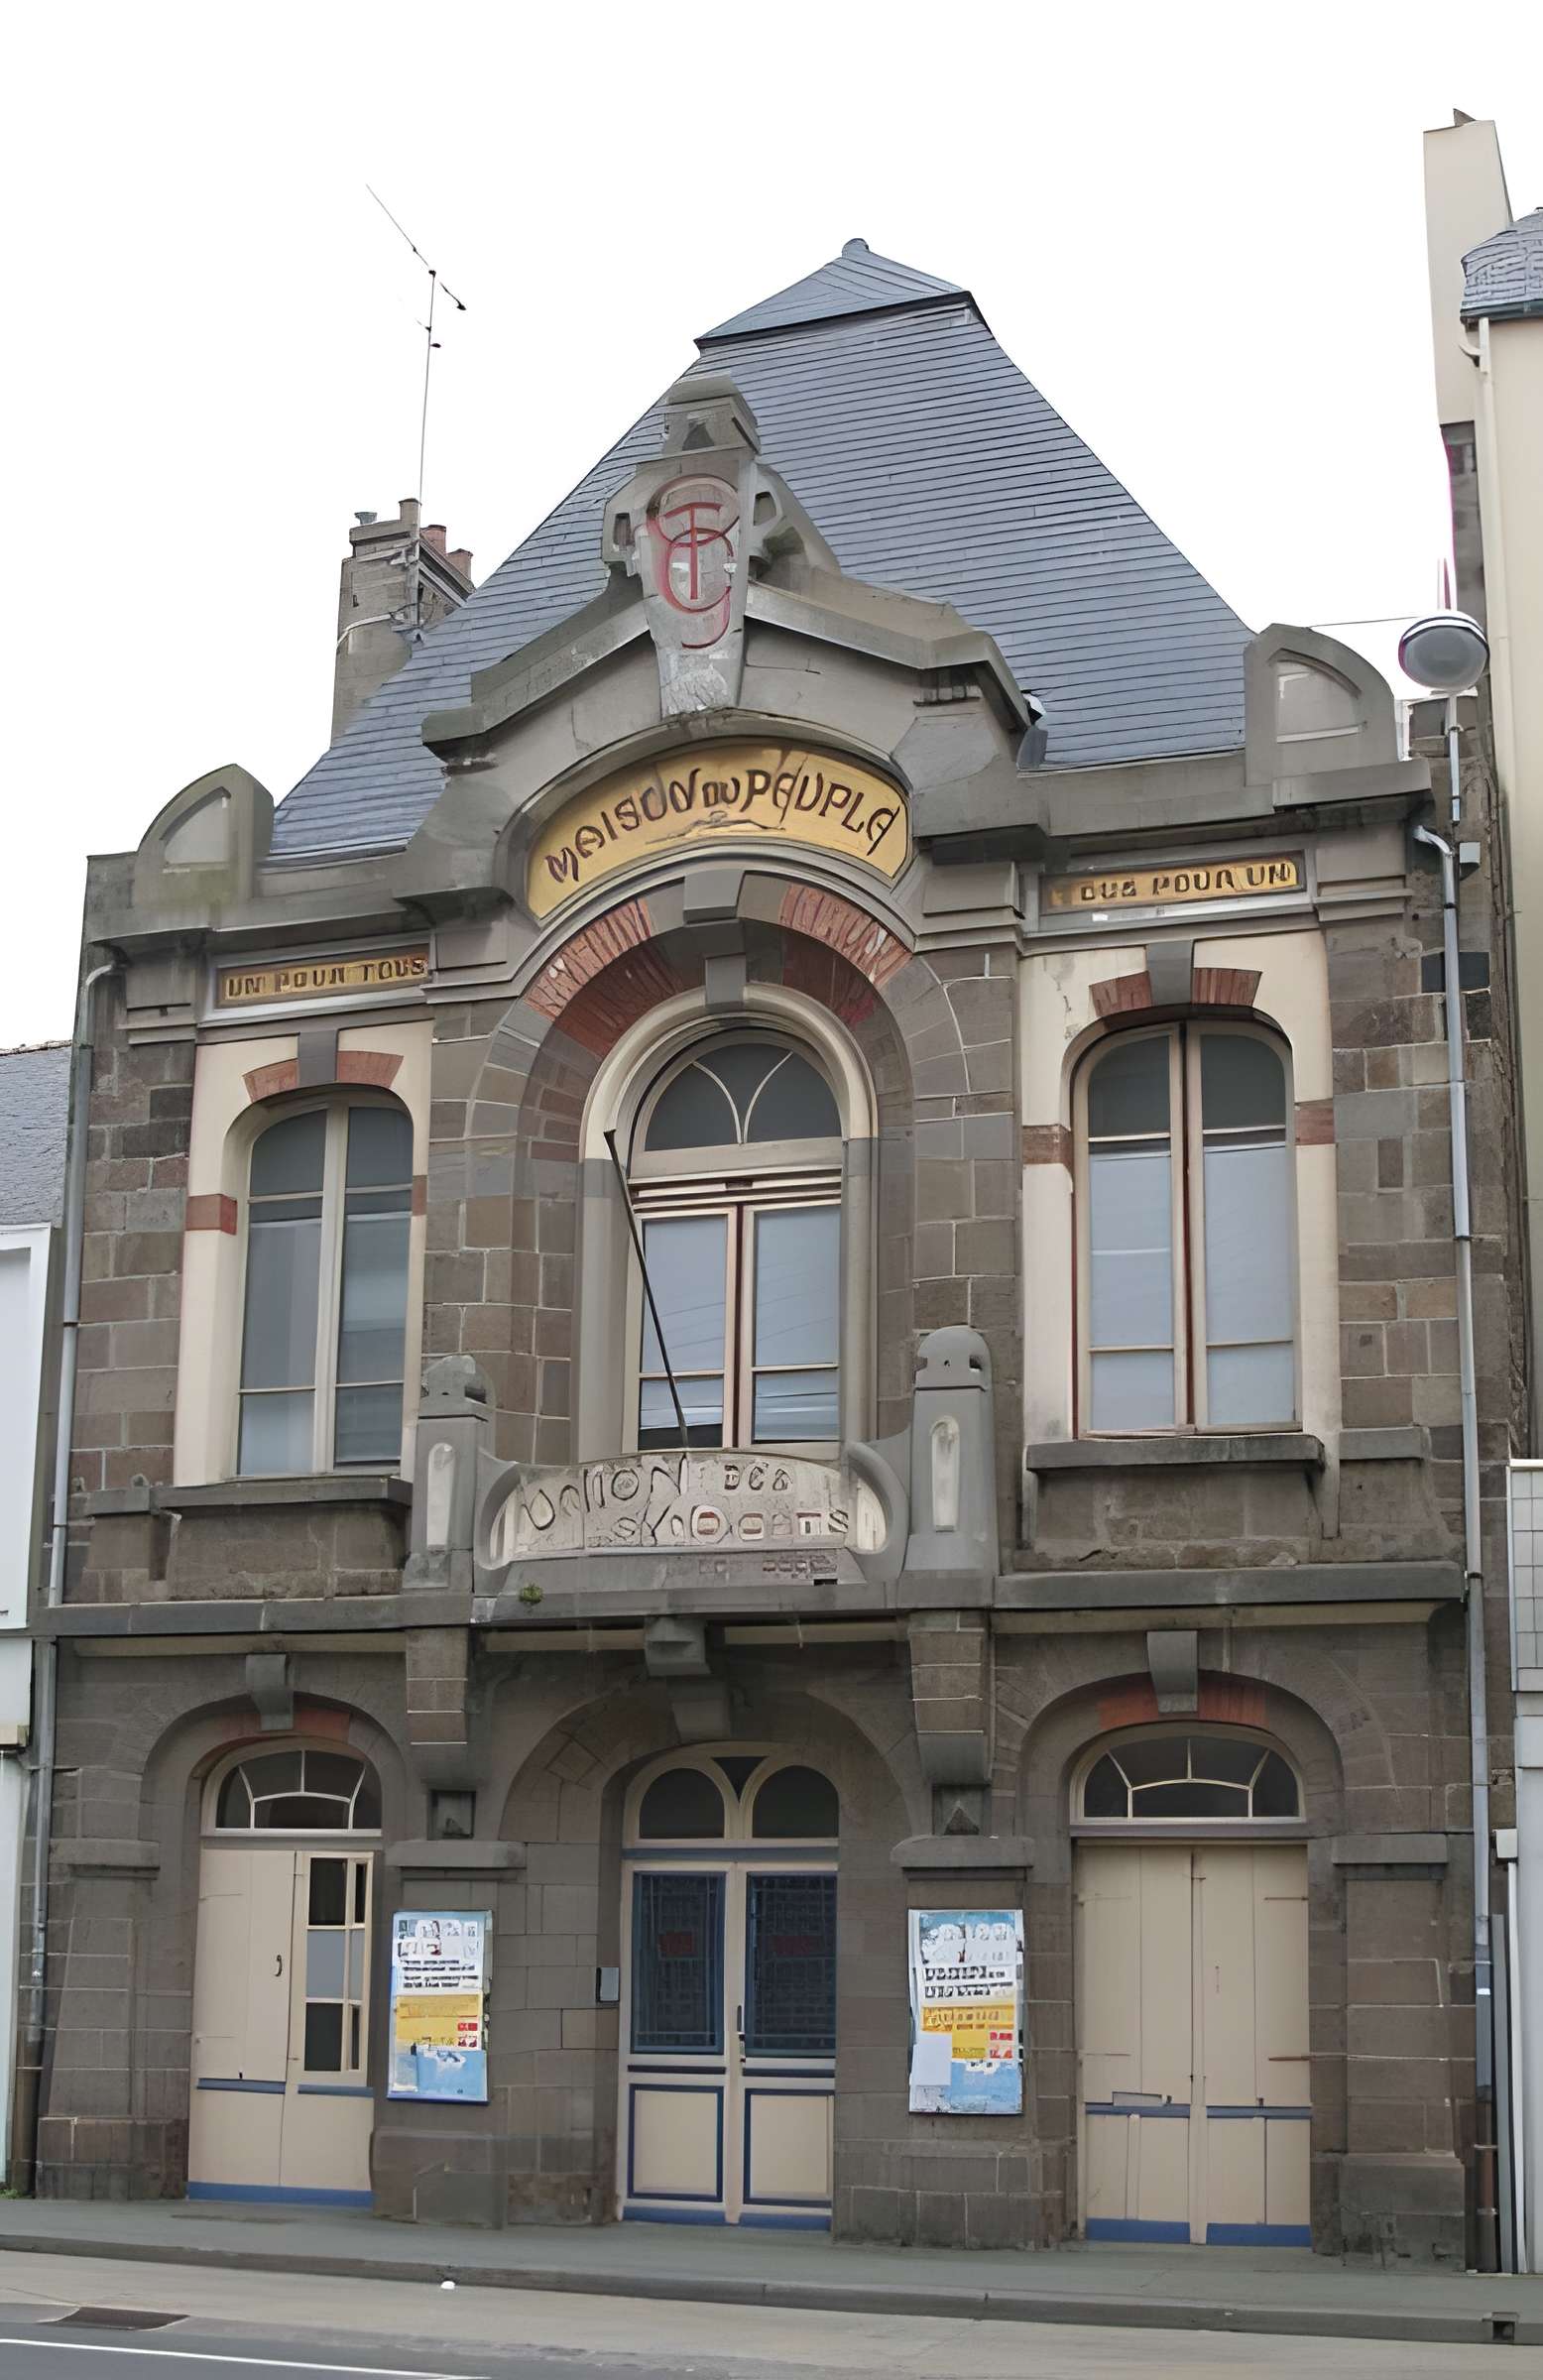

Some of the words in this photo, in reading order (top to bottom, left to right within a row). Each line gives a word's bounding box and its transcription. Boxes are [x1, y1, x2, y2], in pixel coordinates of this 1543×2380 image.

[543, 768, 702, 883] MAISON
[228, 977, 263, 998] UN
[361, 957, 429, 982] TOUS
